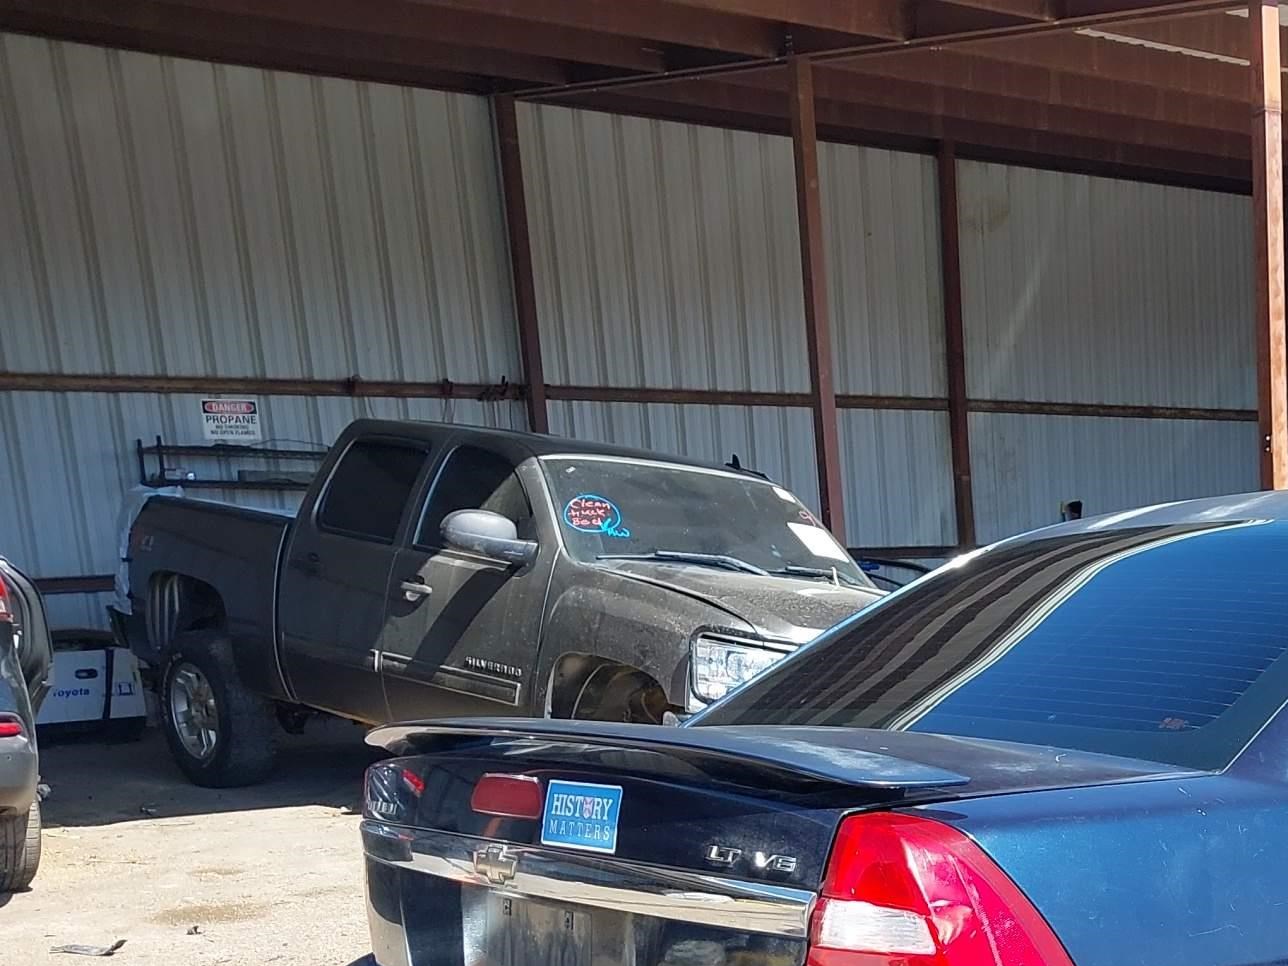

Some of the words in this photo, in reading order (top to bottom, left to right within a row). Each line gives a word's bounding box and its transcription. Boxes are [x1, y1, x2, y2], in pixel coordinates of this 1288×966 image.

[206, 415, 257, 425] PROPANE
[549, 819, 611, 841] MATTERS
[705, 845, 742, 864] LT
[755, 851, 797, 873] V6
